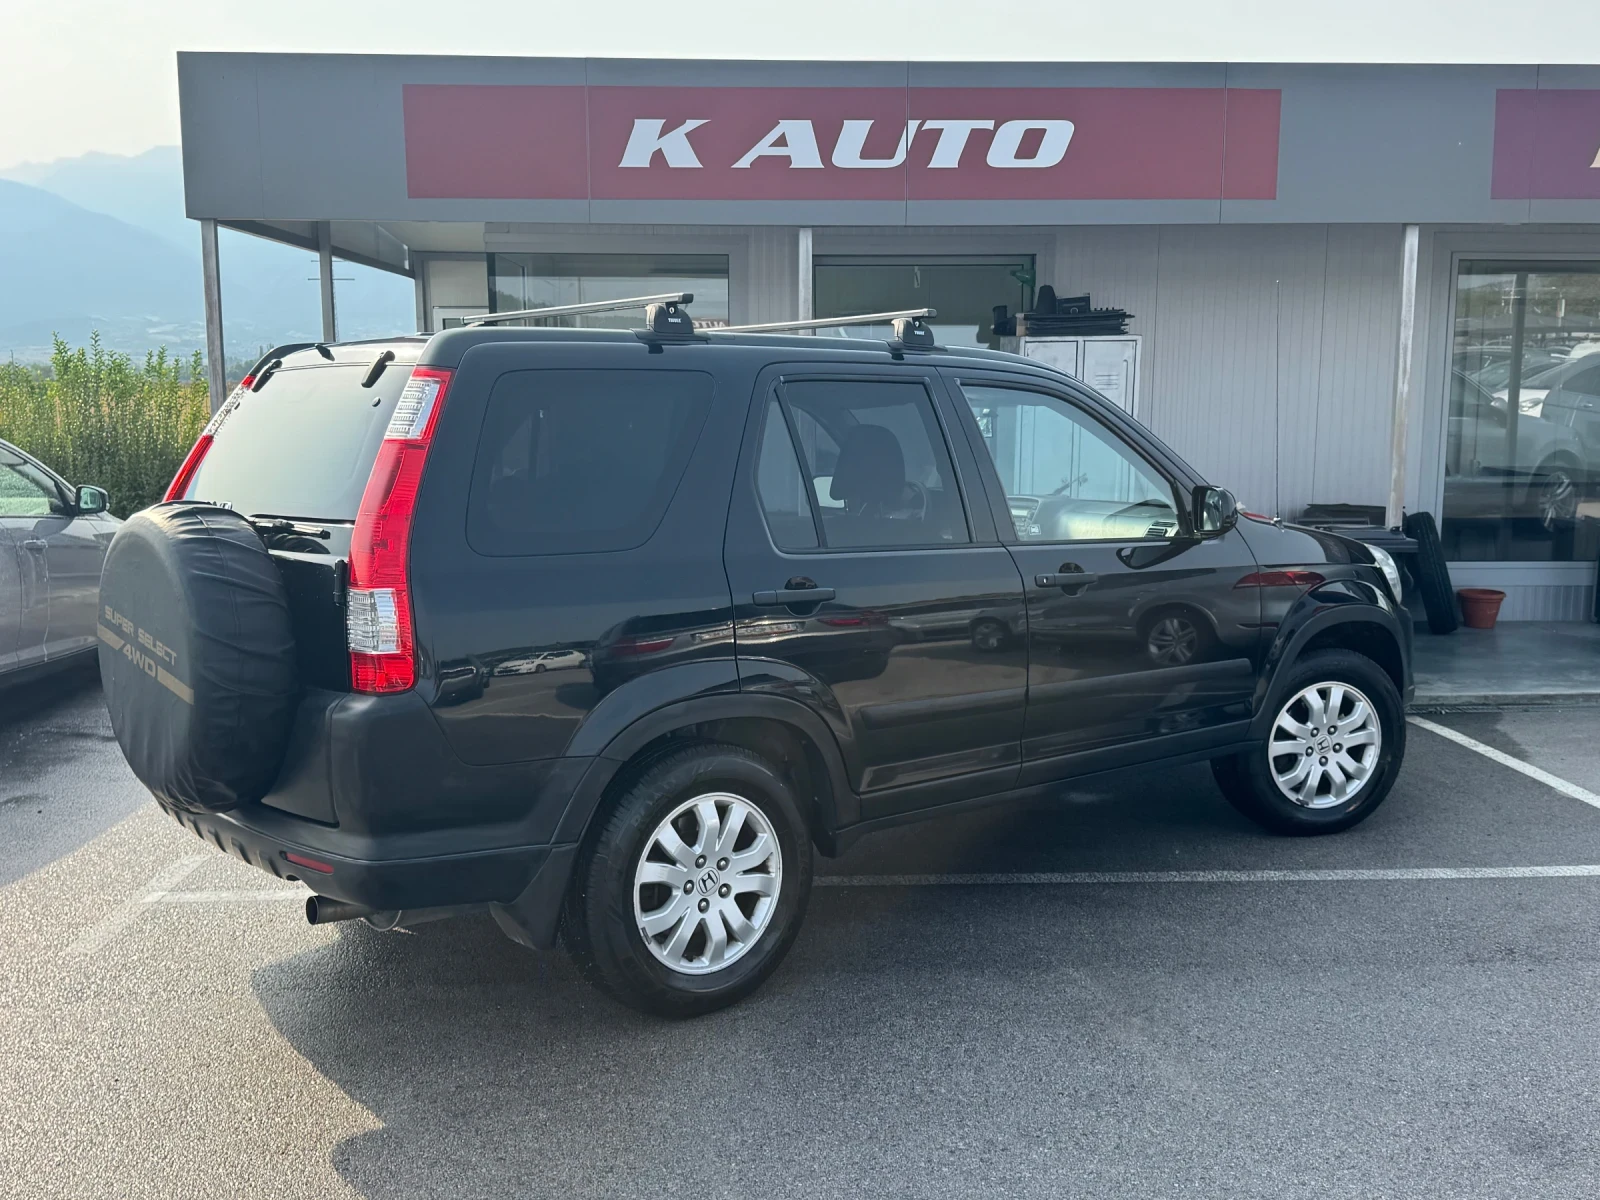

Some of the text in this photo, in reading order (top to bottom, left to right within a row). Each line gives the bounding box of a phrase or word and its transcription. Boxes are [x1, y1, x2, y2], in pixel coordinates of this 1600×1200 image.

[618, 119, 1075, 169] K AUTO
[104, 604, 177, 667] SUPER SELECT
[122, 643, 157, 679] 4WD
